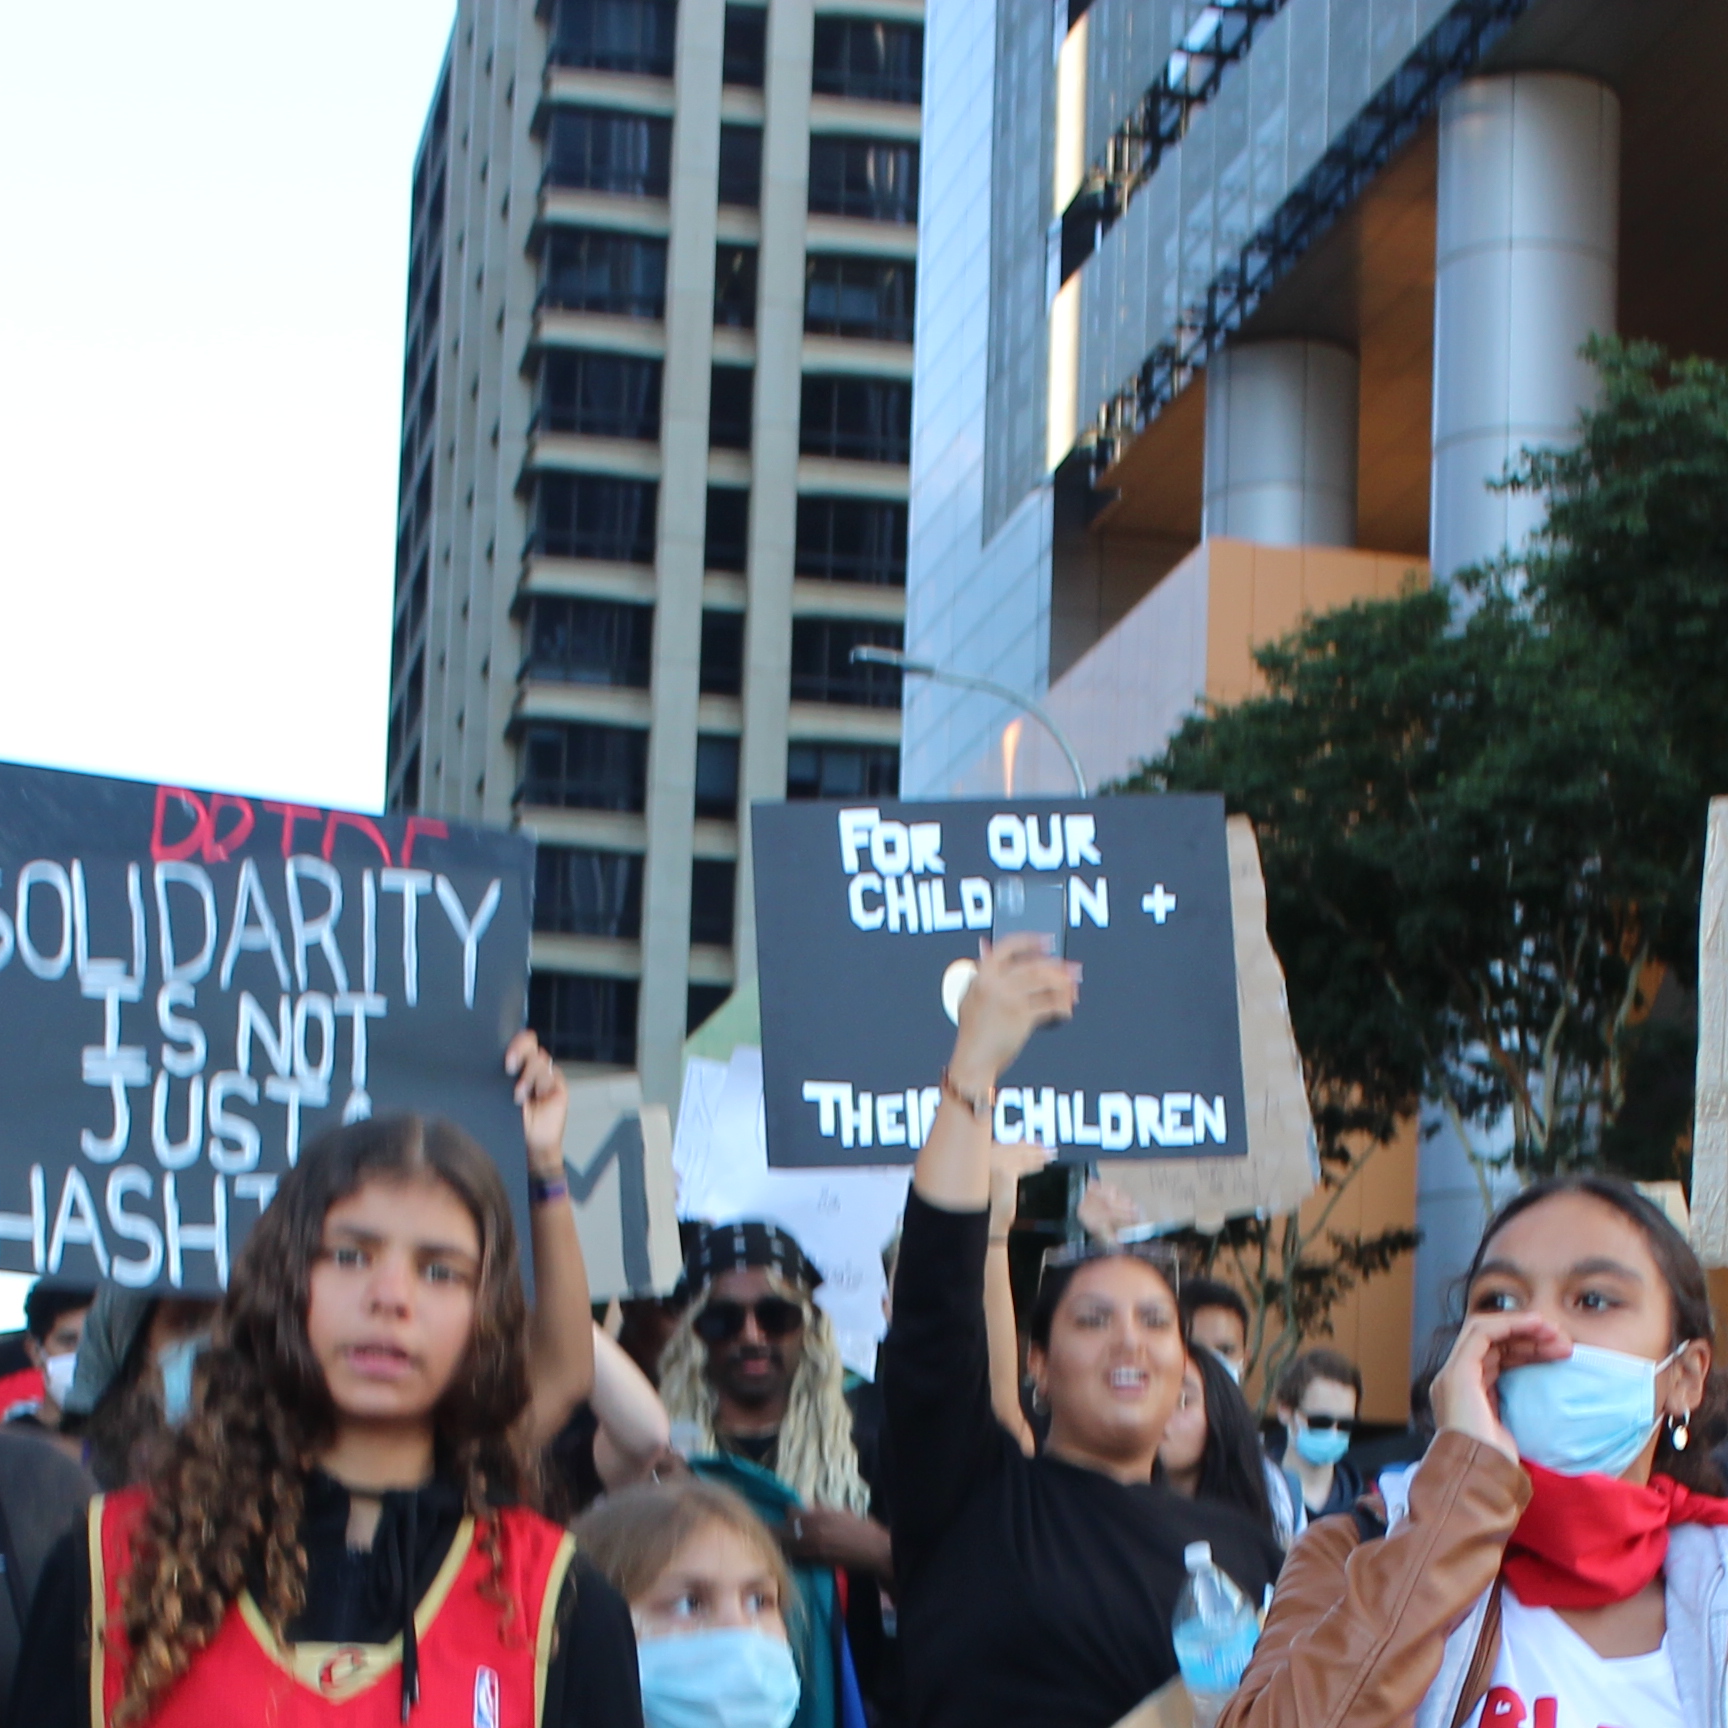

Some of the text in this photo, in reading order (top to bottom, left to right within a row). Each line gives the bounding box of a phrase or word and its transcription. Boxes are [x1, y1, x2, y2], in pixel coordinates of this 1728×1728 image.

[839, 807, 1101, 876] FOR OUR
[848, 871, 1110, 934] CHILDN
[81, 958, 387, 1090] IS NOT
[80, 1061, 329, 1173] JUST
[994, 1086, 1228, 1151] CHILDREN
